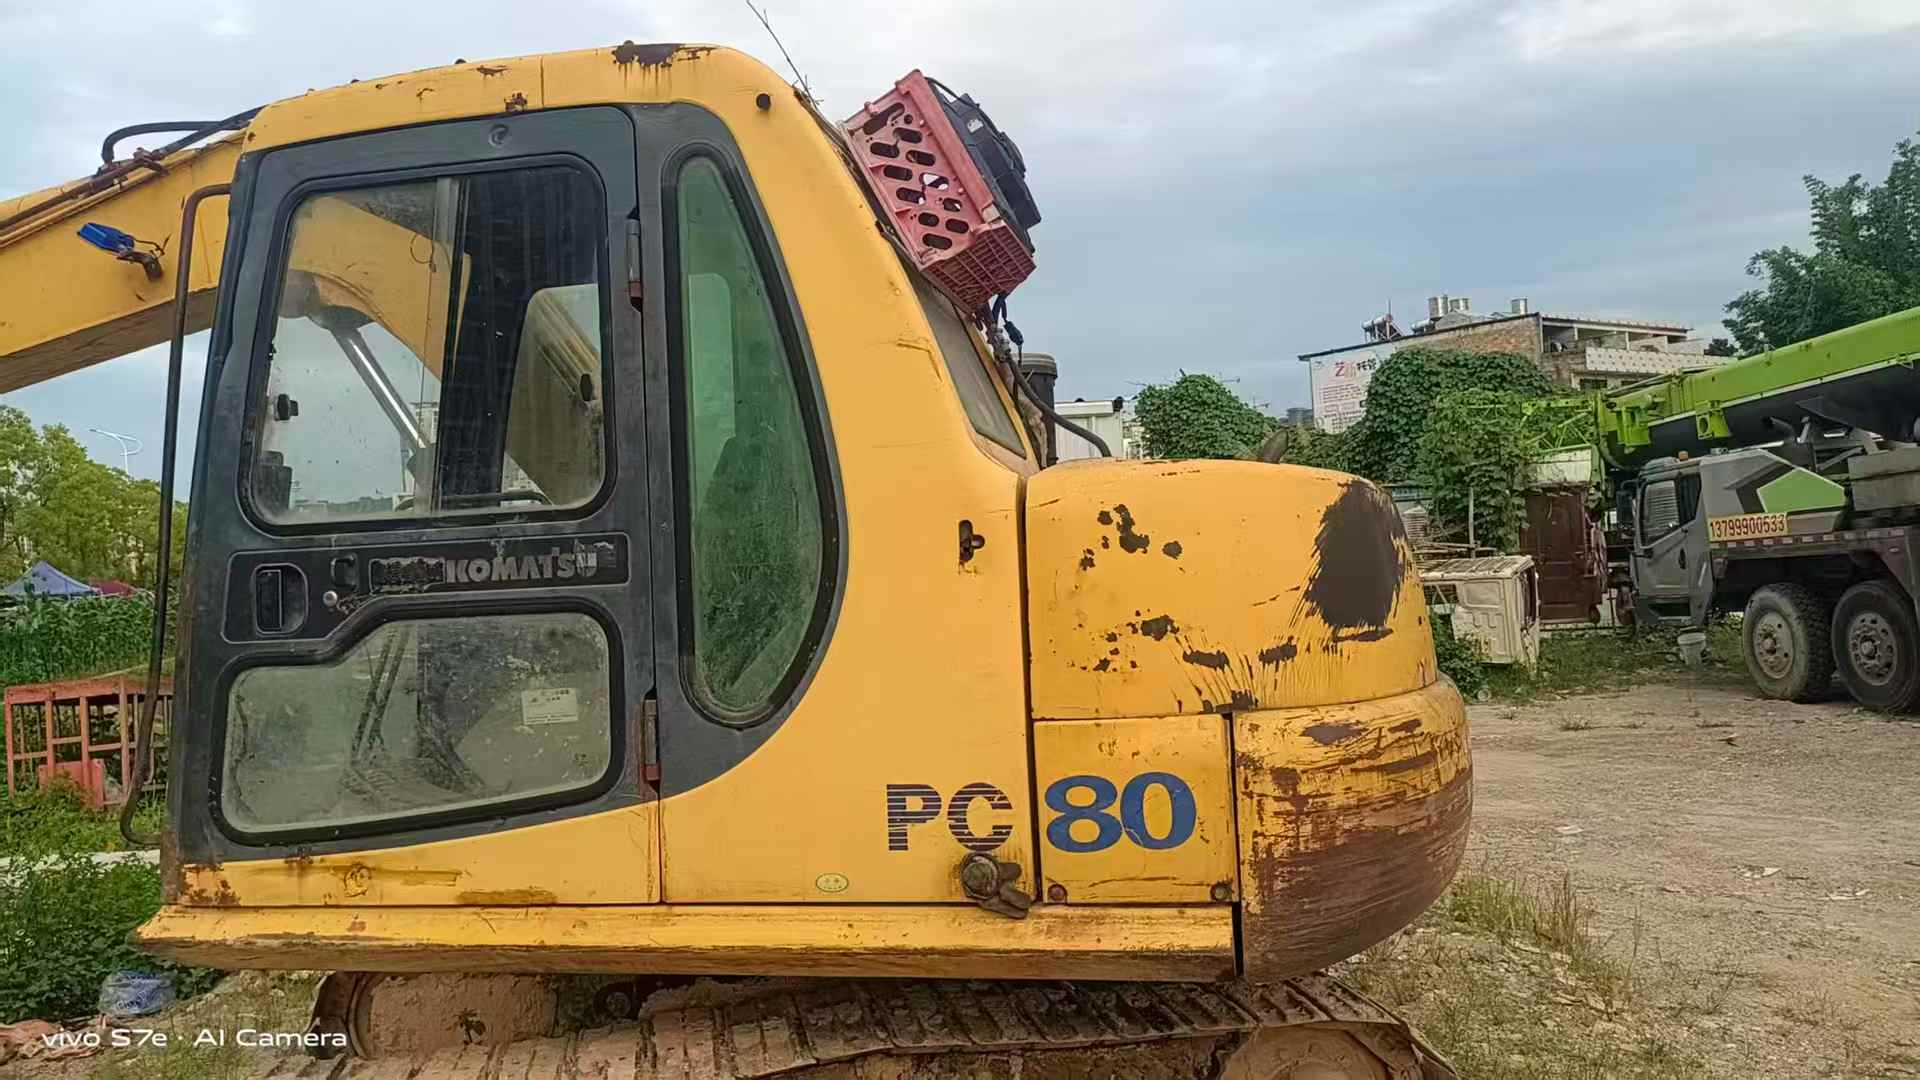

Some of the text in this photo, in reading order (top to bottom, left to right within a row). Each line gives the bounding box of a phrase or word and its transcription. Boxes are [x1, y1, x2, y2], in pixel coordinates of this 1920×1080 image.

[1710, 515, 1785, 537] 13799900533
[447, 551, 597, 583] KOMATSU
[886, 772, 1197, 852] PC 80
